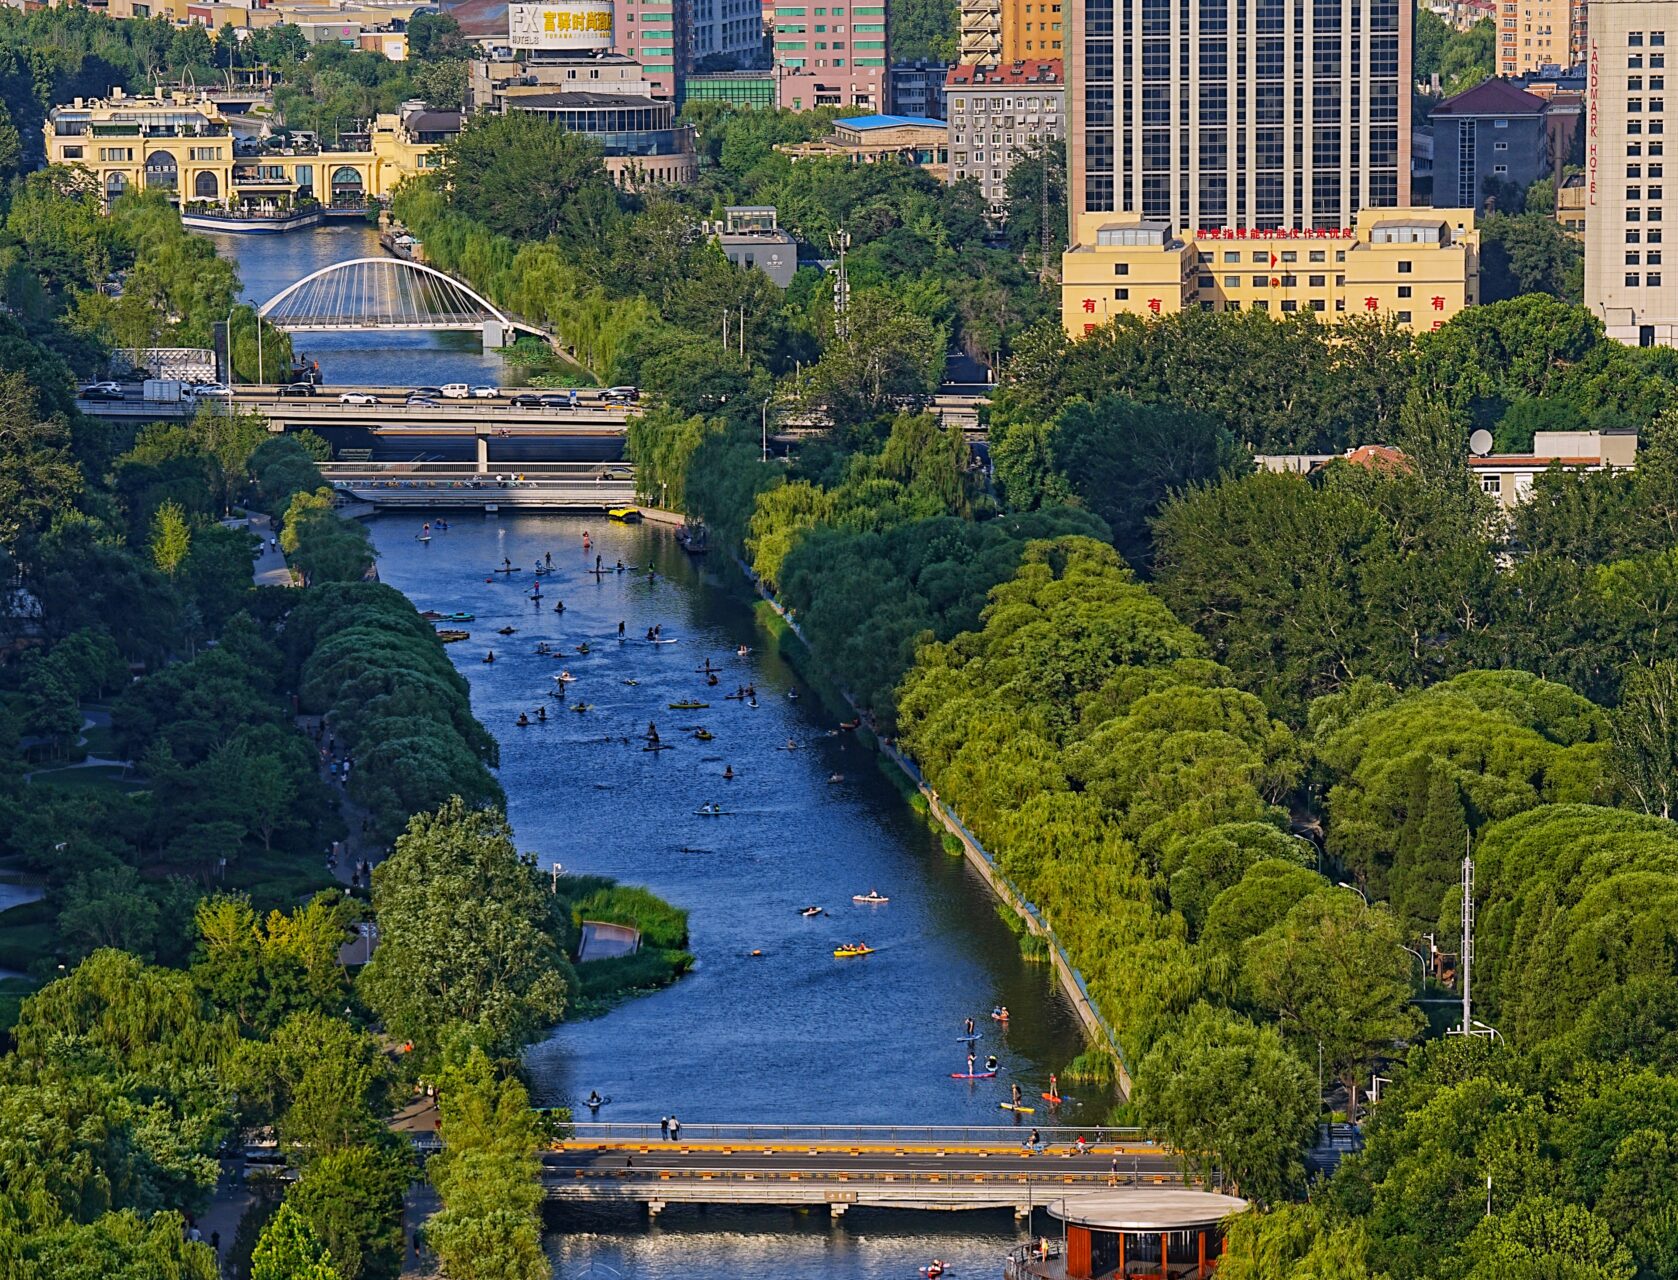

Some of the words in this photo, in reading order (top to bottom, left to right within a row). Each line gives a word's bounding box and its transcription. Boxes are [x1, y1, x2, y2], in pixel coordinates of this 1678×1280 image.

[513, 7, 539, 33] FX
[1590, 38, 1599, 137] LANDMARK
[1589, 144, 1598, 206] HOTEL
